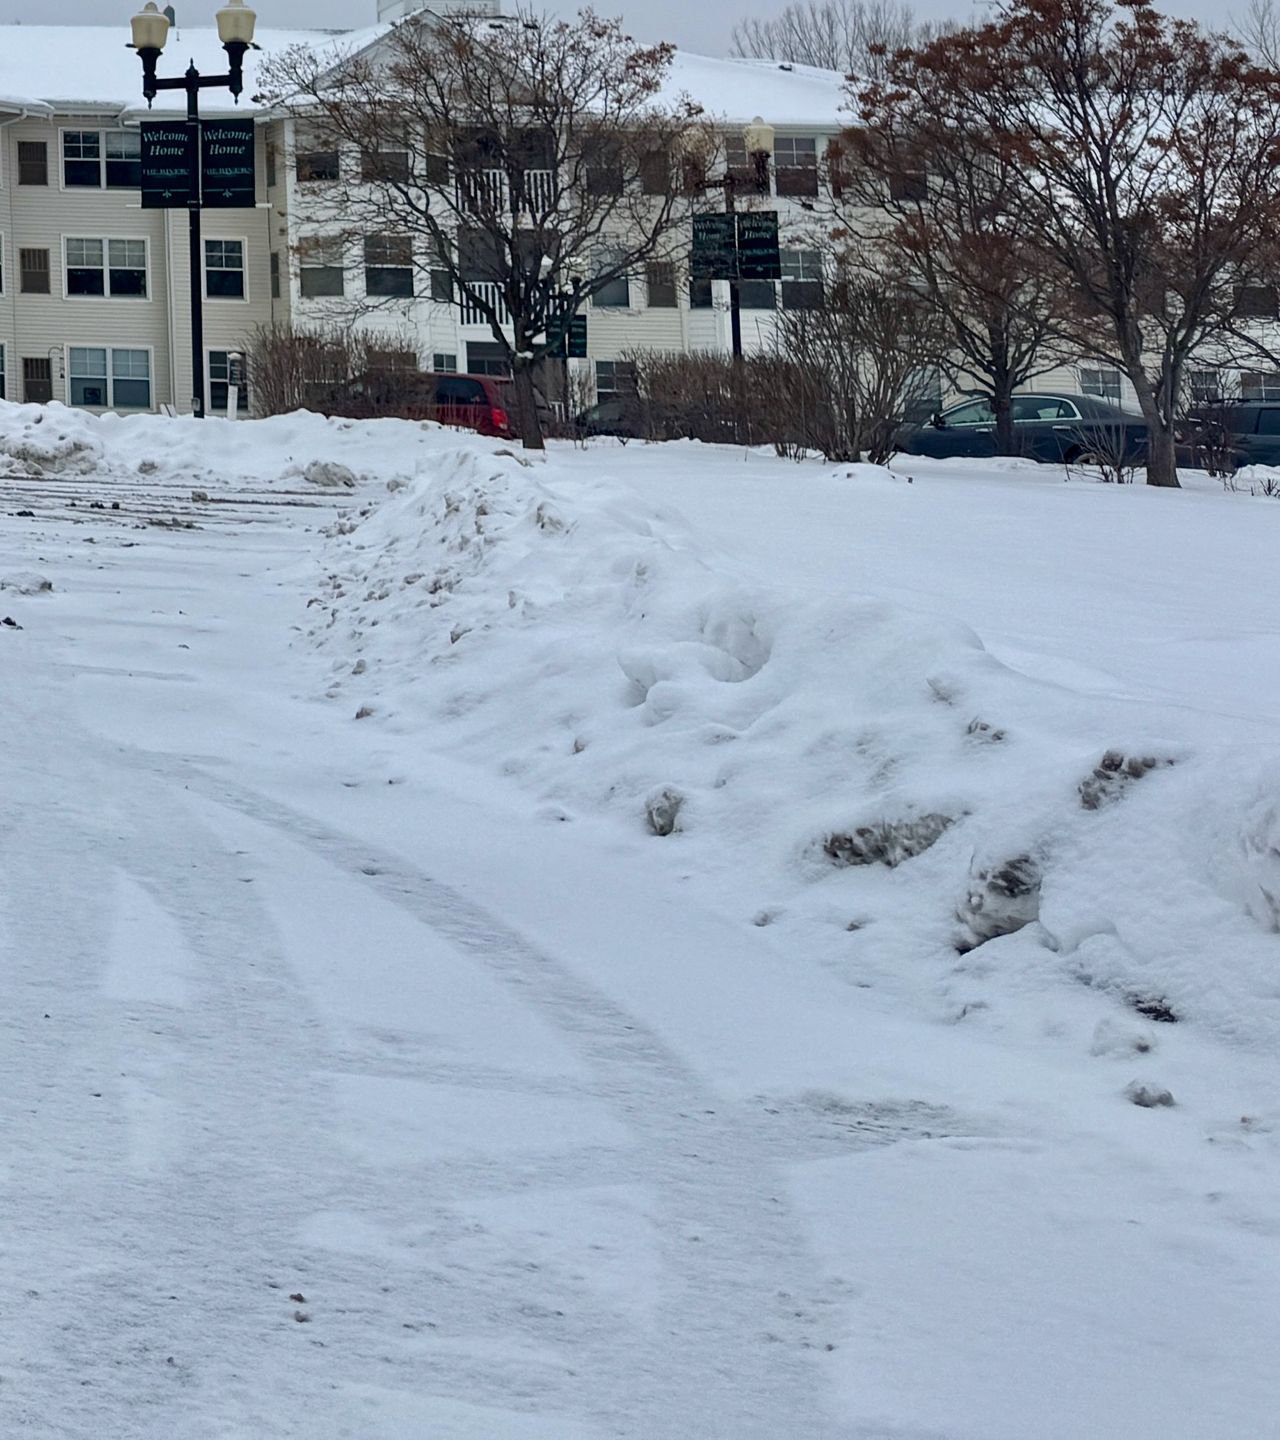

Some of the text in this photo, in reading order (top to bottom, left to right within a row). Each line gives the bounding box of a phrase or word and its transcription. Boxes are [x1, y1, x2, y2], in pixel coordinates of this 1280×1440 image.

[203, 128, 253, 142] Welcome
[149, 145, 185, 156] Home
[209, 143, 246, 156] Home
